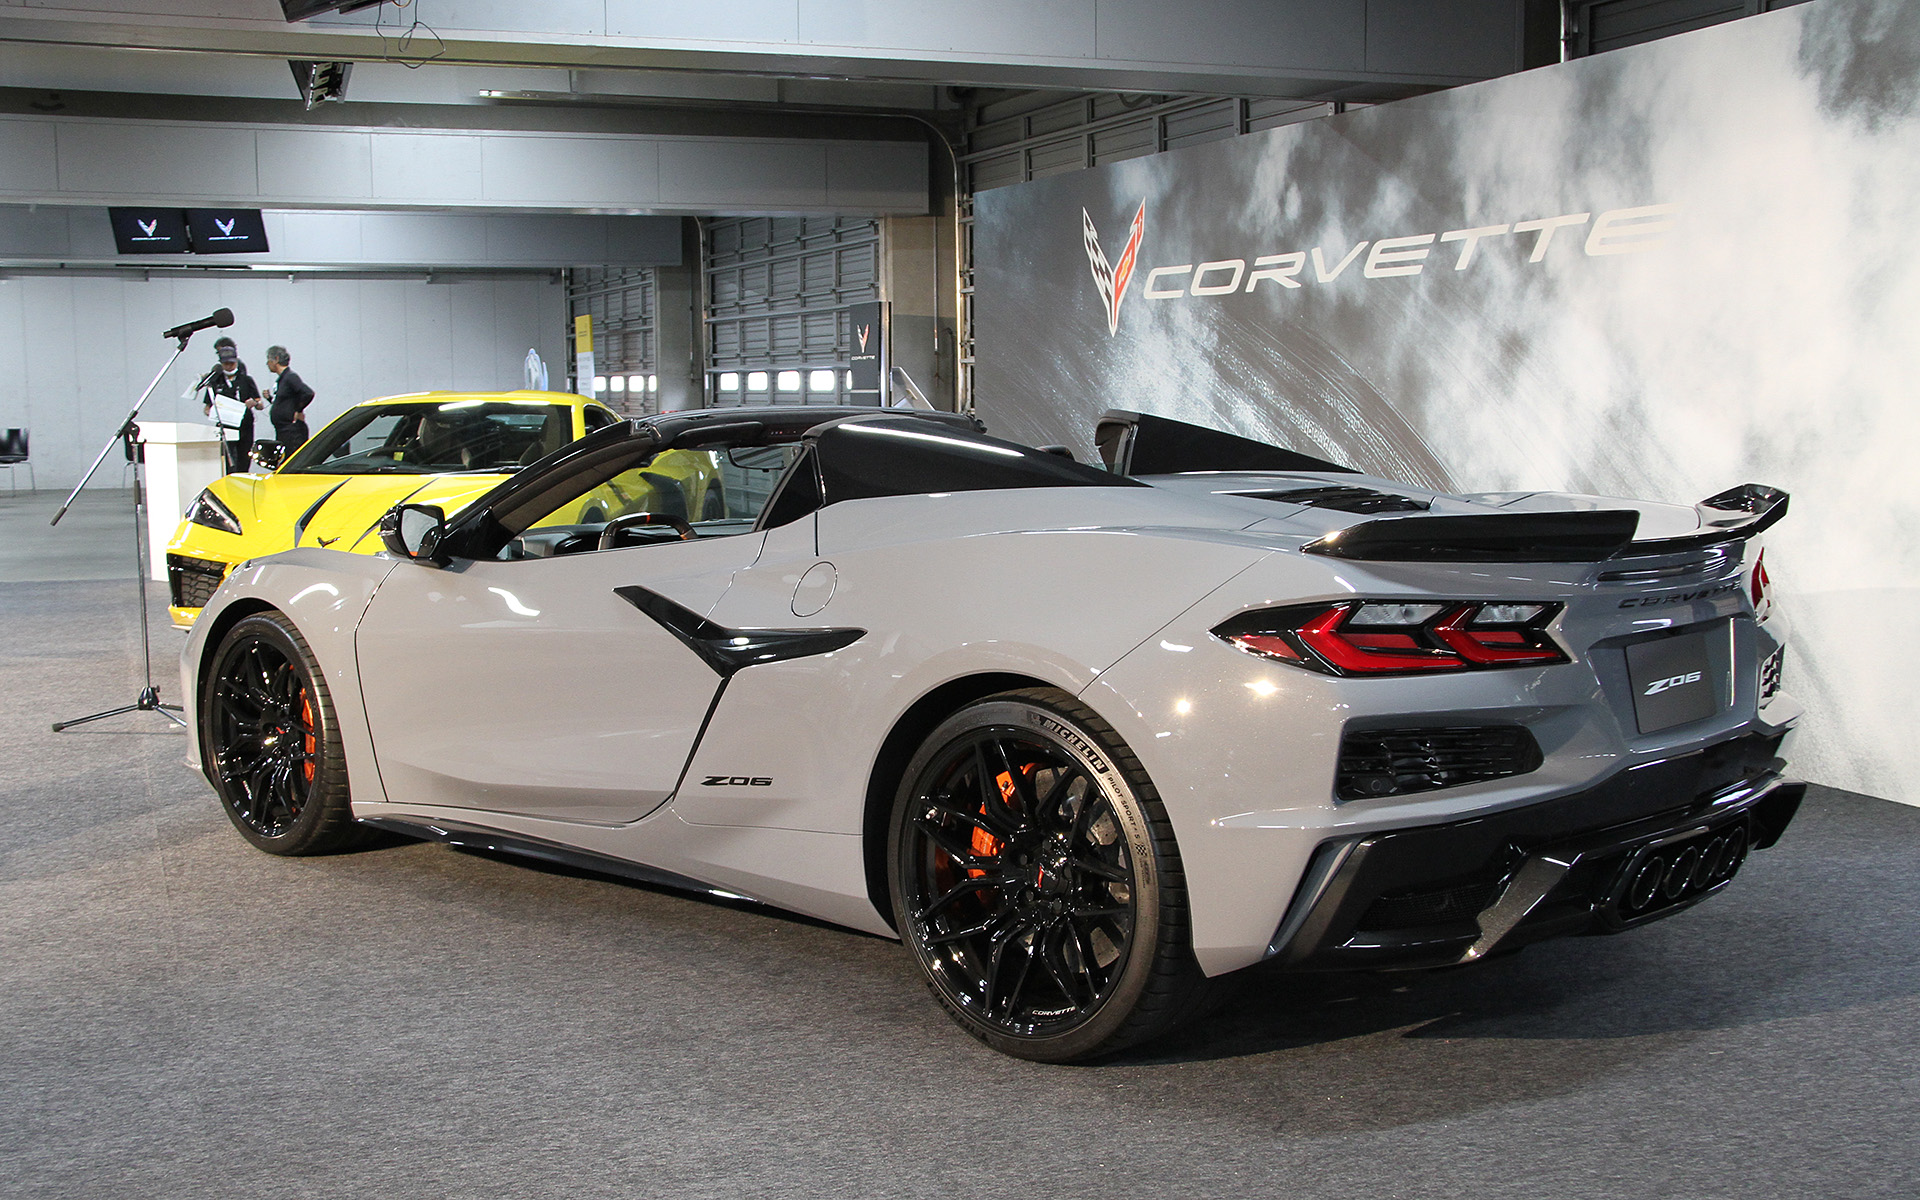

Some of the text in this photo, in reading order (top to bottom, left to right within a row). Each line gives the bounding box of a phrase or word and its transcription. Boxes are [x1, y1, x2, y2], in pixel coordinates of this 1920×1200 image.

[1143, 200, 1684, 299] CORVETTE
[1618, 580, 1741, 608] CORVETTE
[1644, 671, 1701, 695] Z06
[1043, 719, 1105, 770] MICHELIN
[700, 776, 773, 786] Z06
[1108, 777, 1124, 798] PILOT
[1120, 800, 1137, 828] SPORT
[1031, 1006, 1076, 1016] CORVETTE
